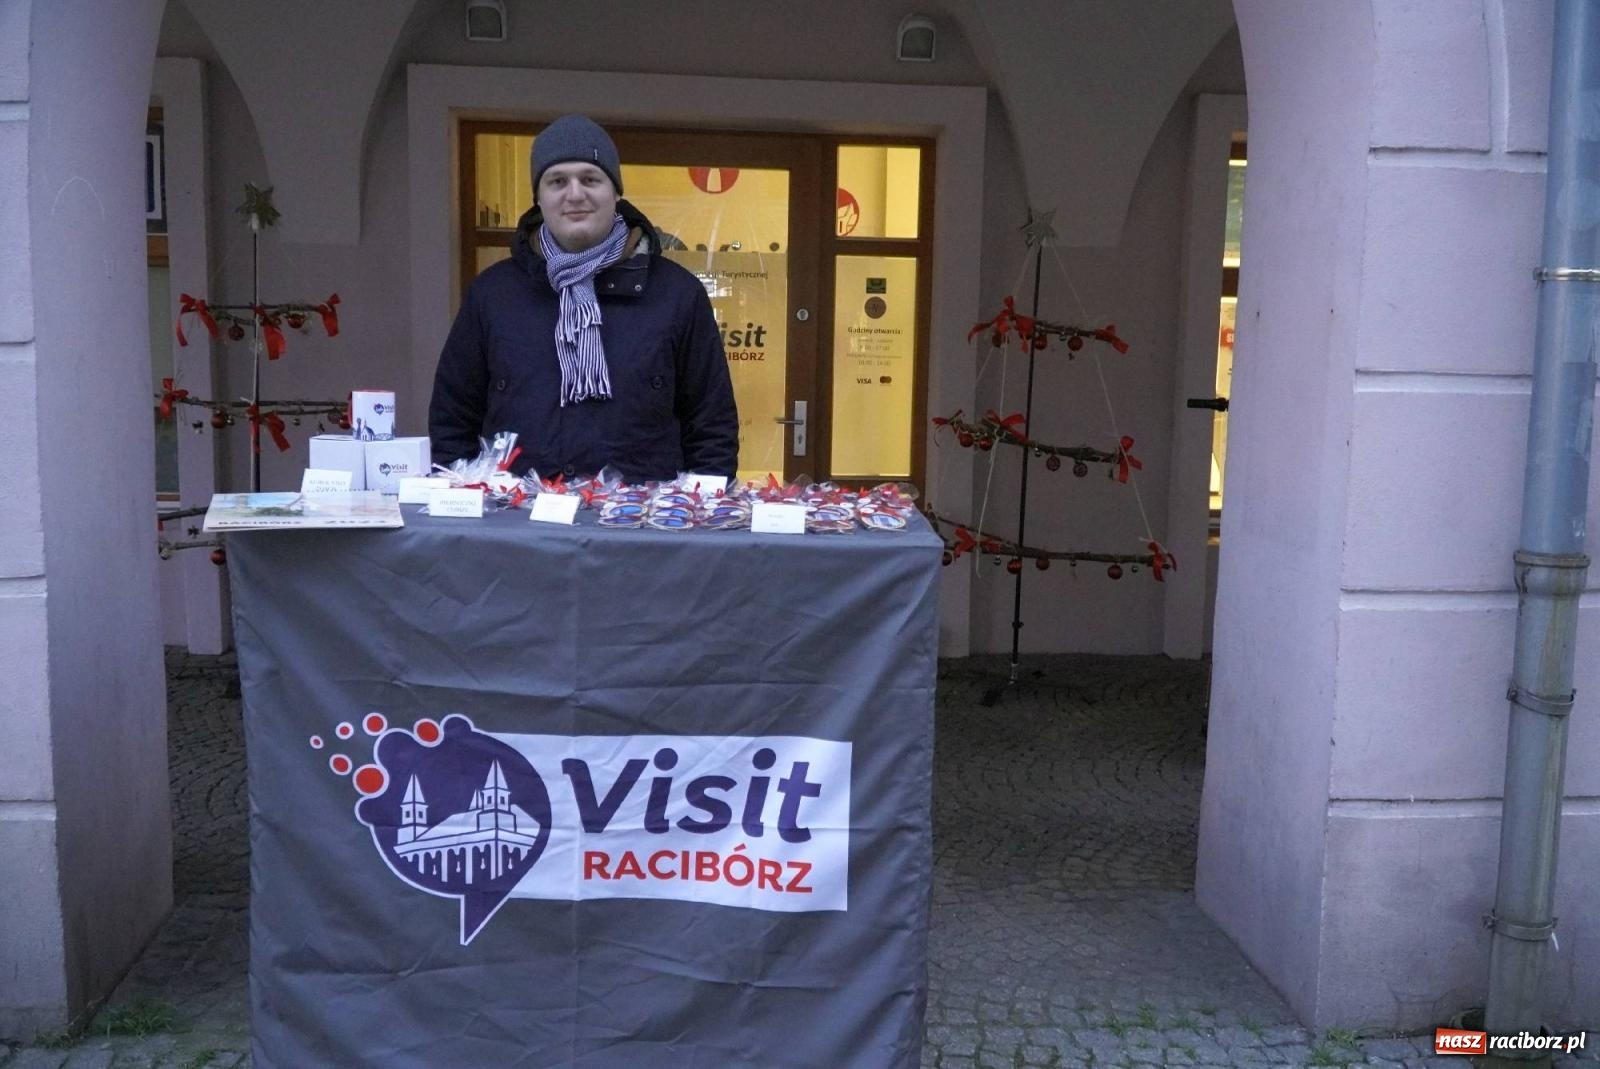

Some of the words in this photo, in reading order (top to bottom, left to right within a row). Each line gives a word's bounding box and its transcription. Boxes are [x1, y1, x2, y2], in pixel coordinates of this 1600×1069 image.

[718, 322, 767, 347] isit
[561, 748, 822, 844] Visit
[583, 843, 813, 893] RACIBÓRZ
